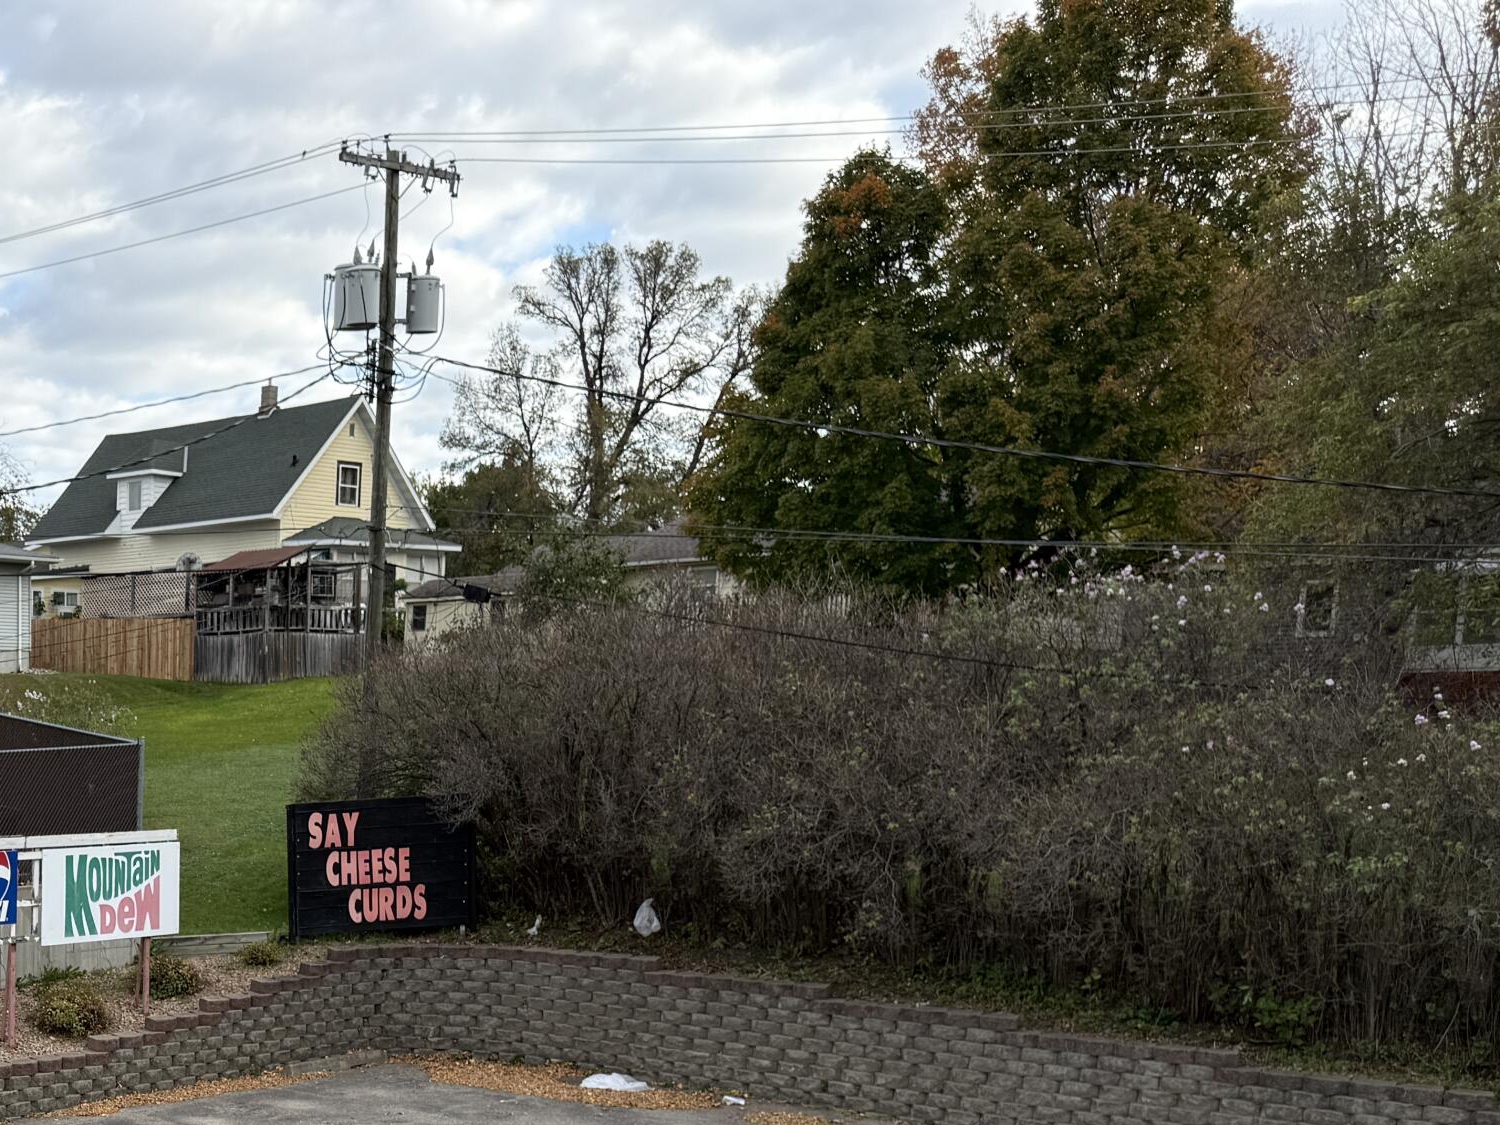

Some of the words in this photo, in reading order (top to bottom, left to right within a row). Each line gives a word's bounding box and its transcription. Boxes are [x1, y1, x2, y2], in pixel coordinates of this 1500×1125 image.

[308, 812, 359, 848] SAY
[326, 847, 411, 886] CHEESE
[348, 884, 427, 923] CURDS
